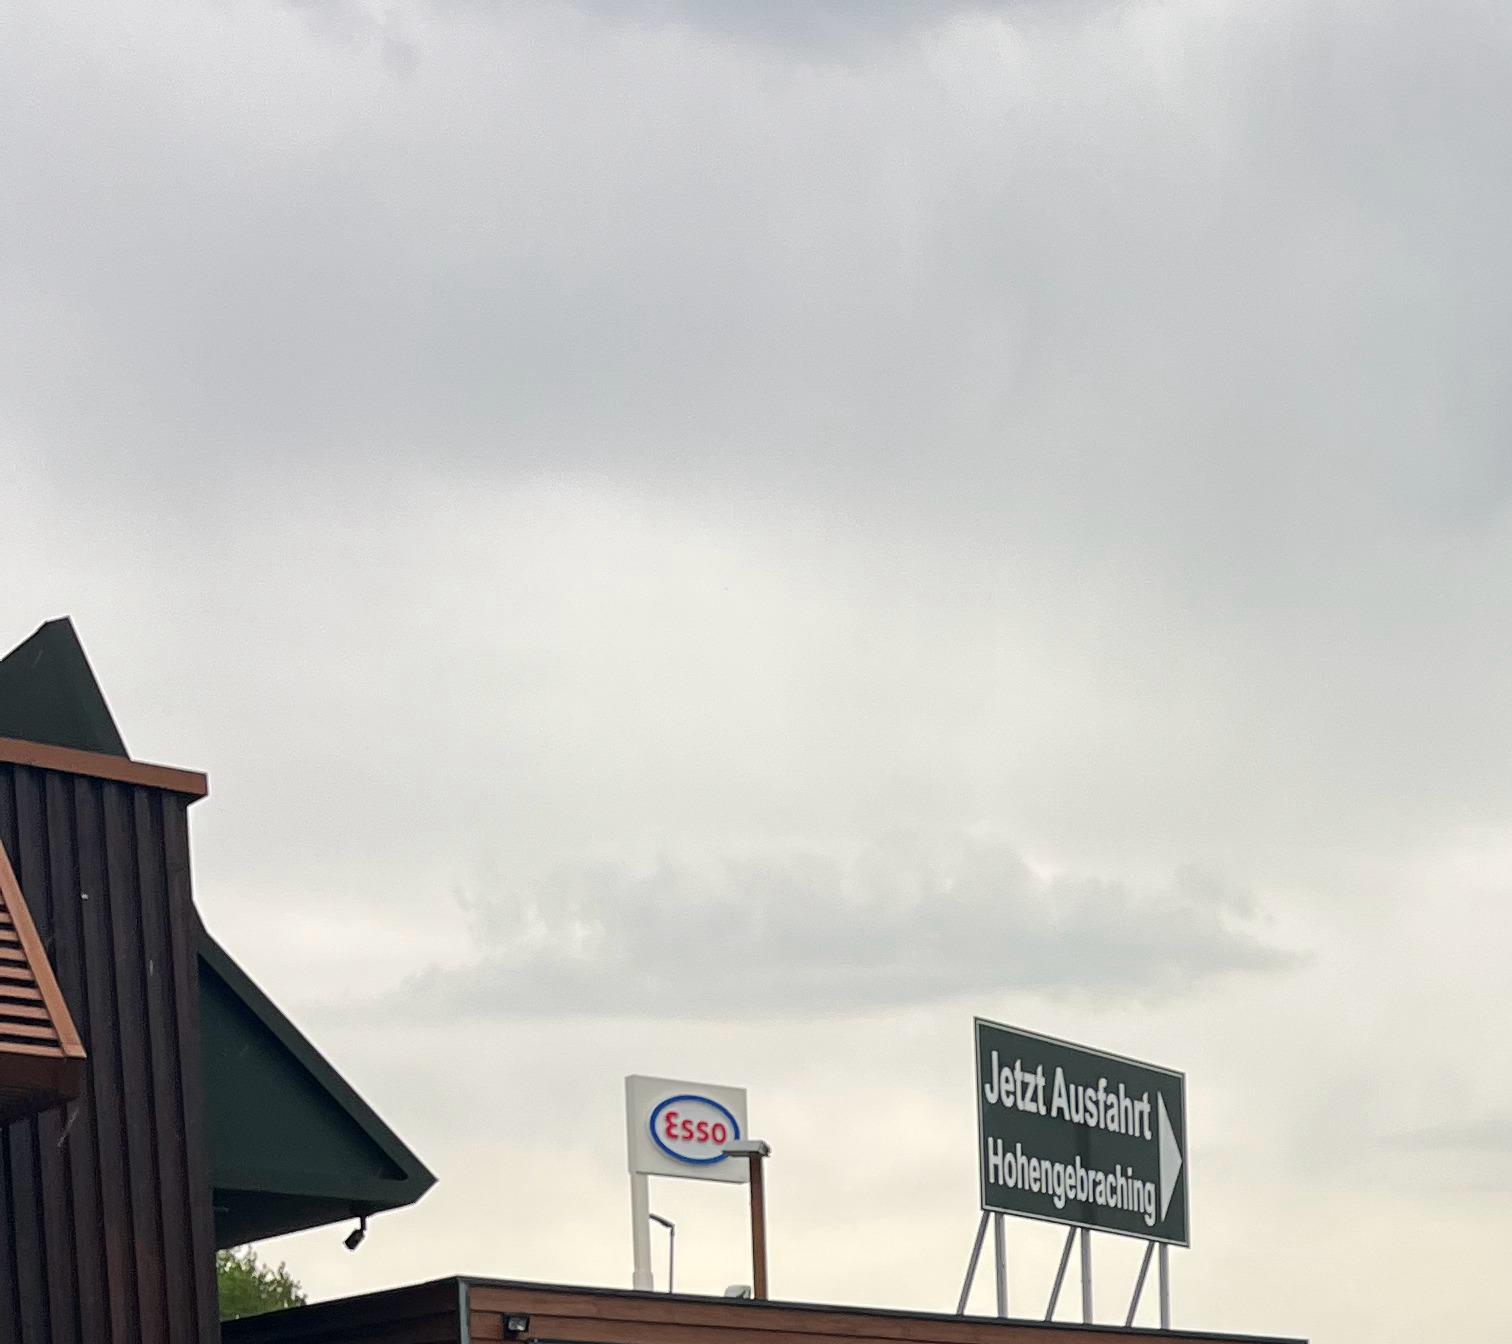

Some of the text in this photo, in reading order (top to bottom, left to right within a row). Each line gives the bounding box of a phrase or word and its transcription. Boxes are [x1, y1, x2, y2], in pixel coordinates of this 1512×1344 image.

[664, 1110, 727, 1145] Esso
[984, 1050, 1152, 1141] Jetzt Ausfahrt
[987, 1136, 1157, 1226] Hohengebraching
